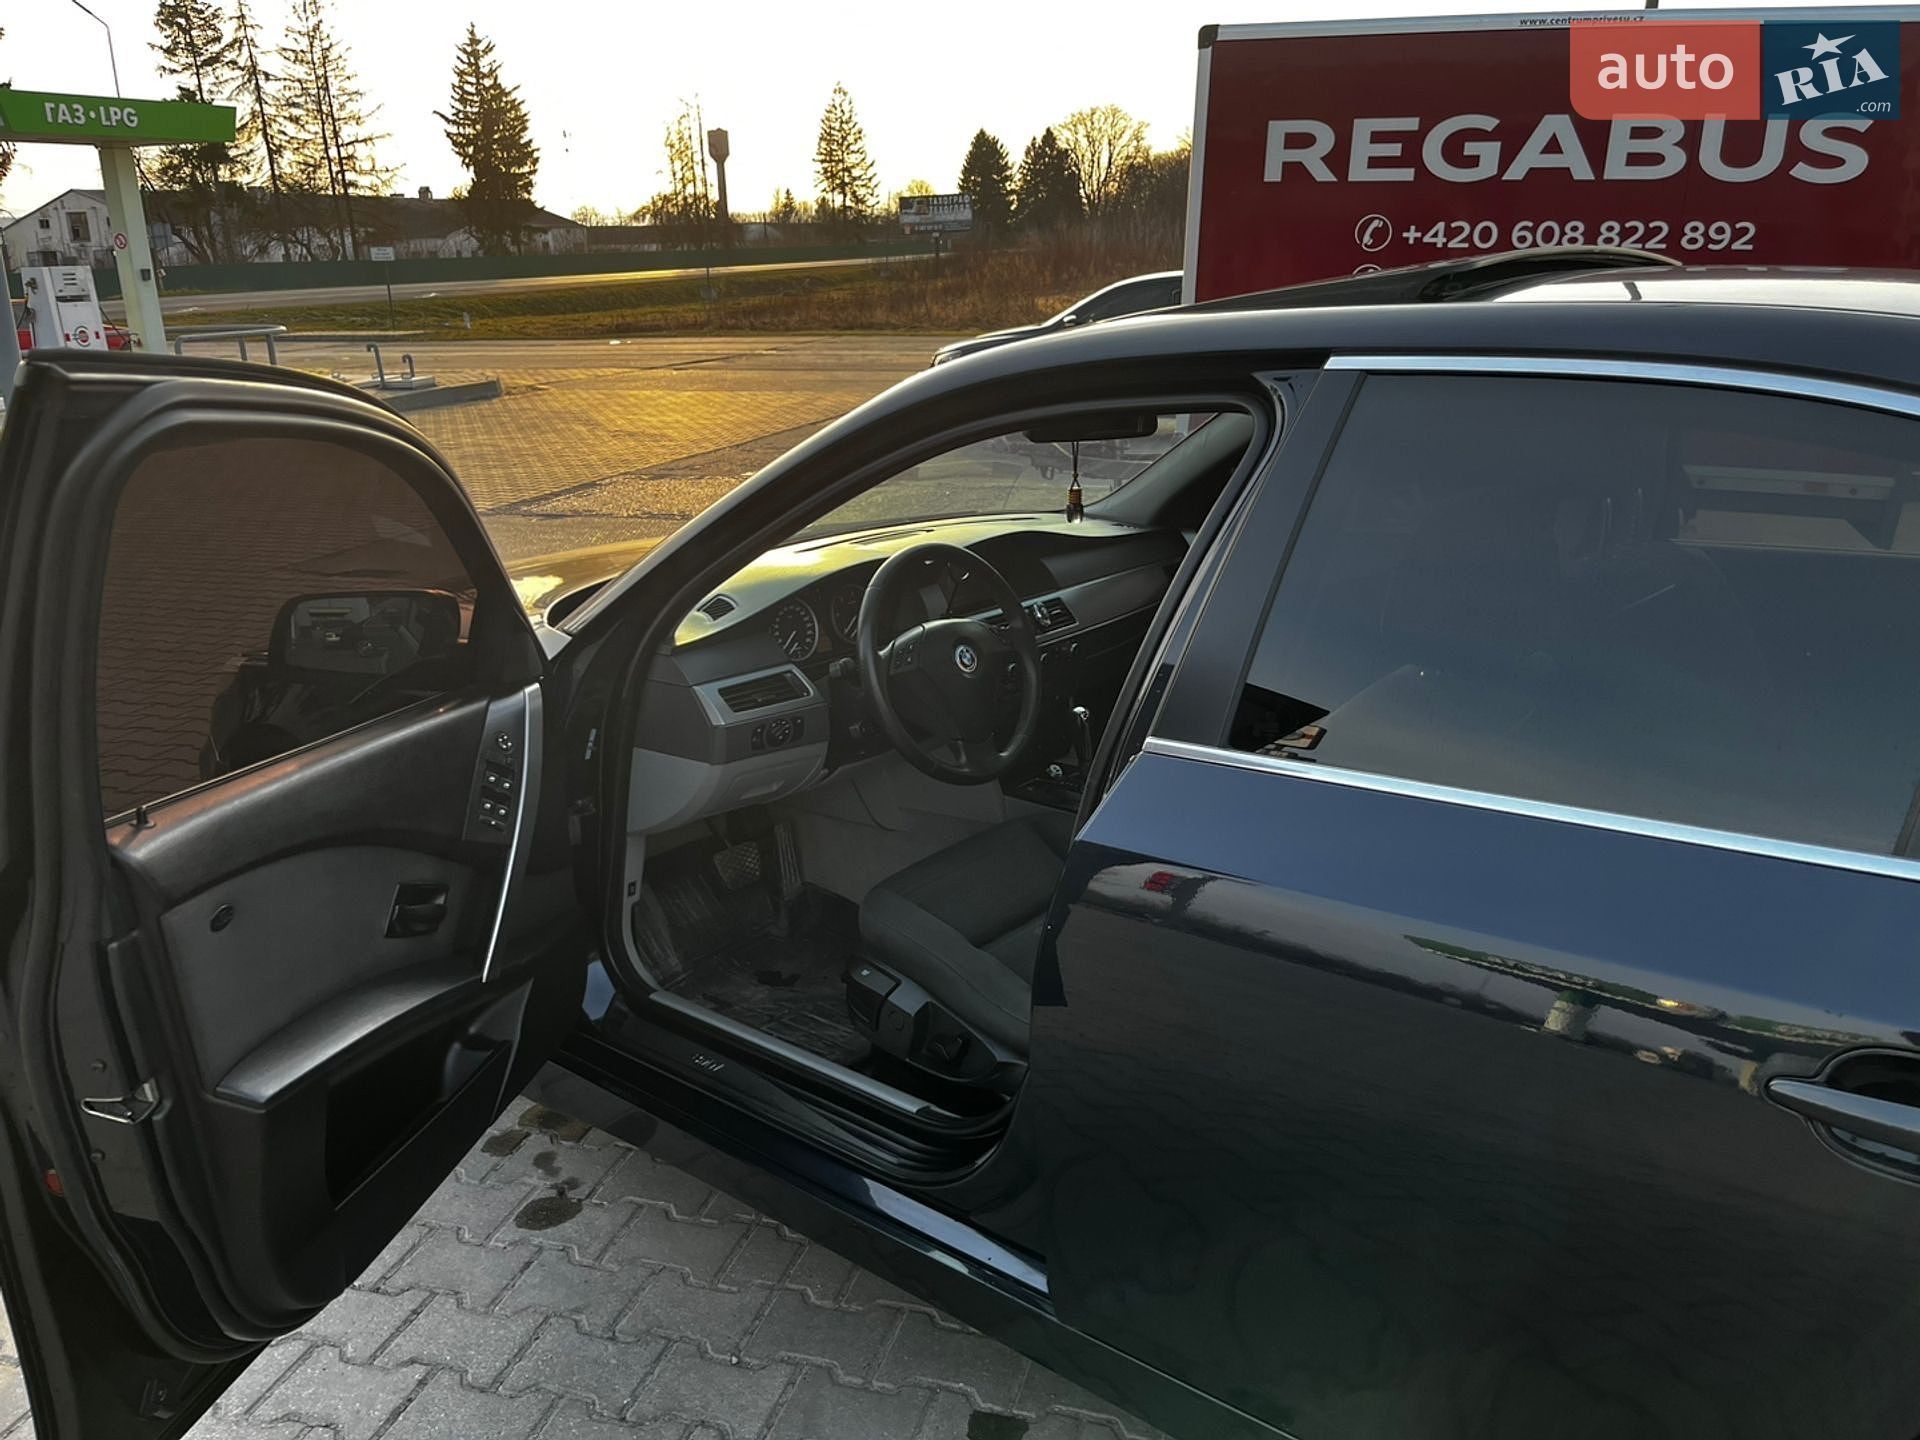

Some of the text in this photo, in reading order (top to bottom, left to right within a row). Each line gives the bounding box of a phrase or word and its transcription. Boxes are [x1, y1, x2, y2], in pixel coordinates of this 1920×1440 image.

[1263, 113, 1874, 184] REGABUS
[1402, 221, 1755, 250] +420 608 822 892
